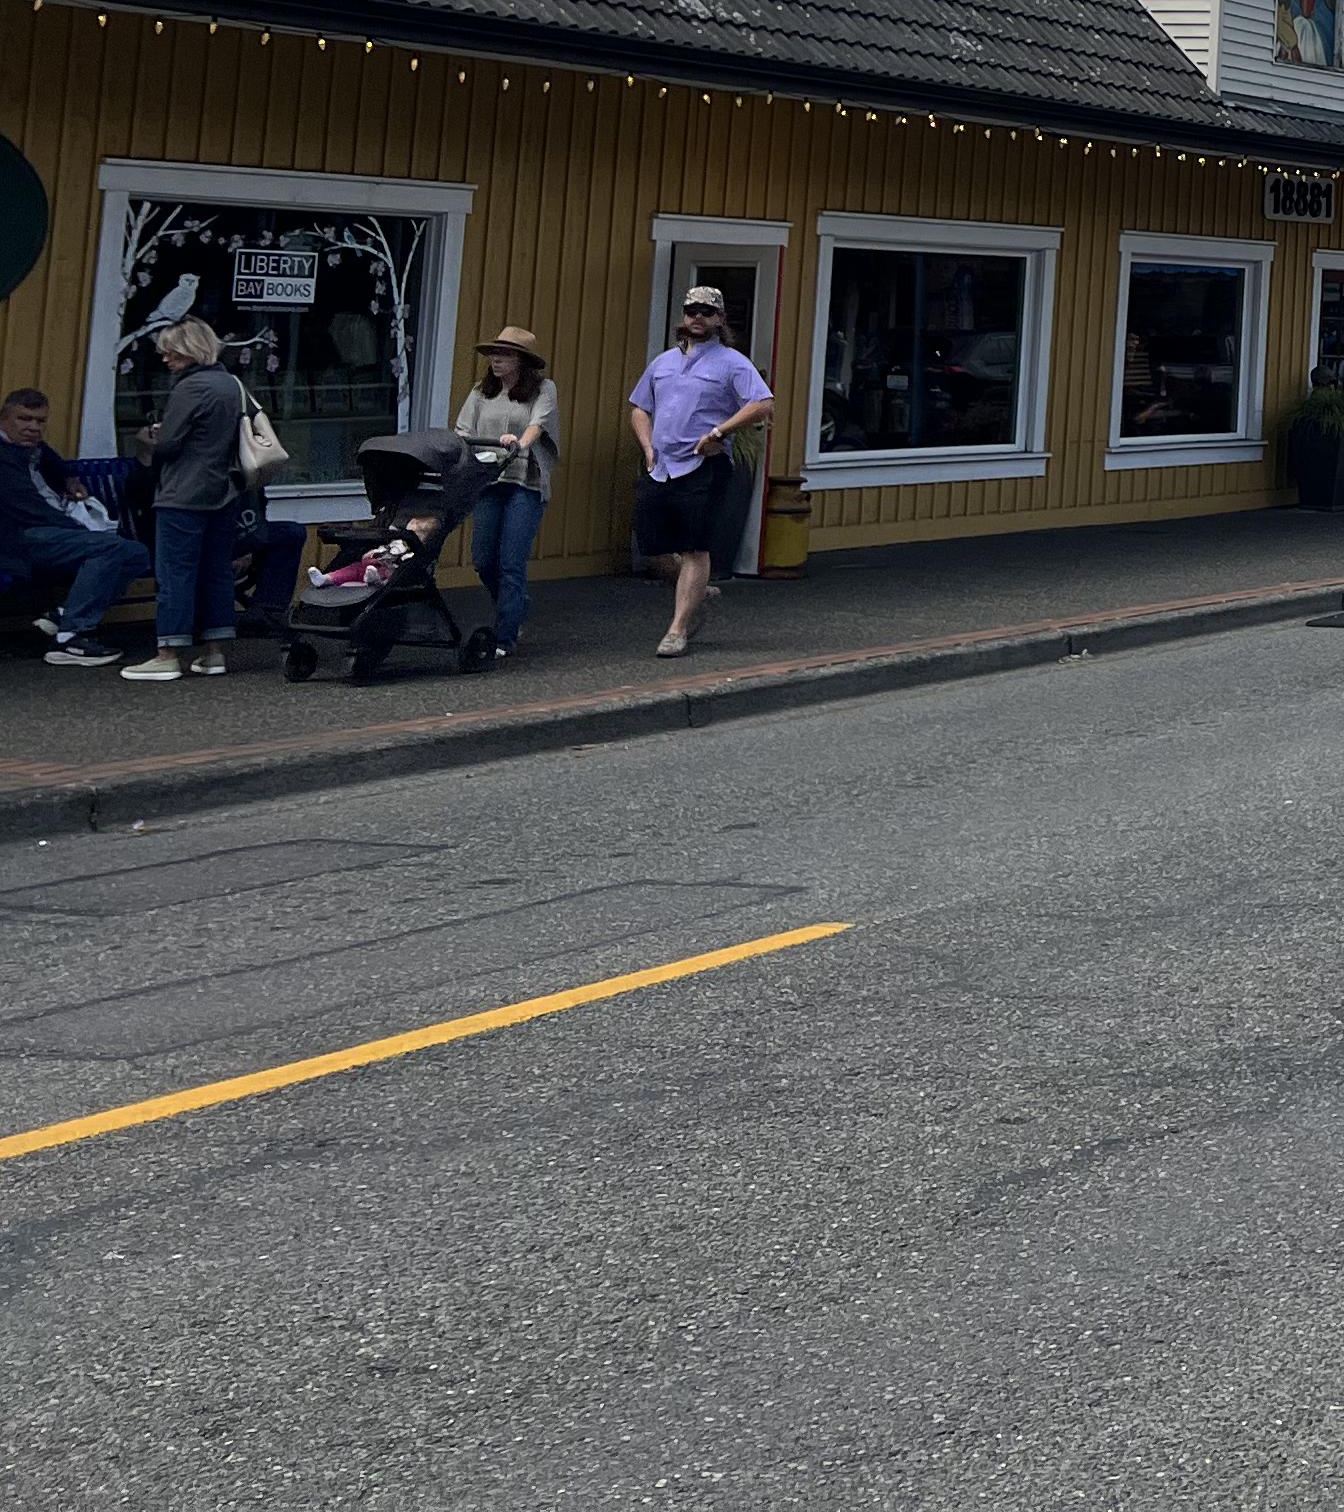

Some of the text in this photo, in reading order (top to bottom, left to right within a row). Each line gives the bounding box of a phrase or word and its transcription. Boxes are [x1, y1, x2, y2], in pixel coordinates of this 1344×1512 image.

[1270, 178, 1332, 218] 18881
[240, 254, 313, 276] LIBERTY
[237, 281, 312, 297] BAY BOOKS
